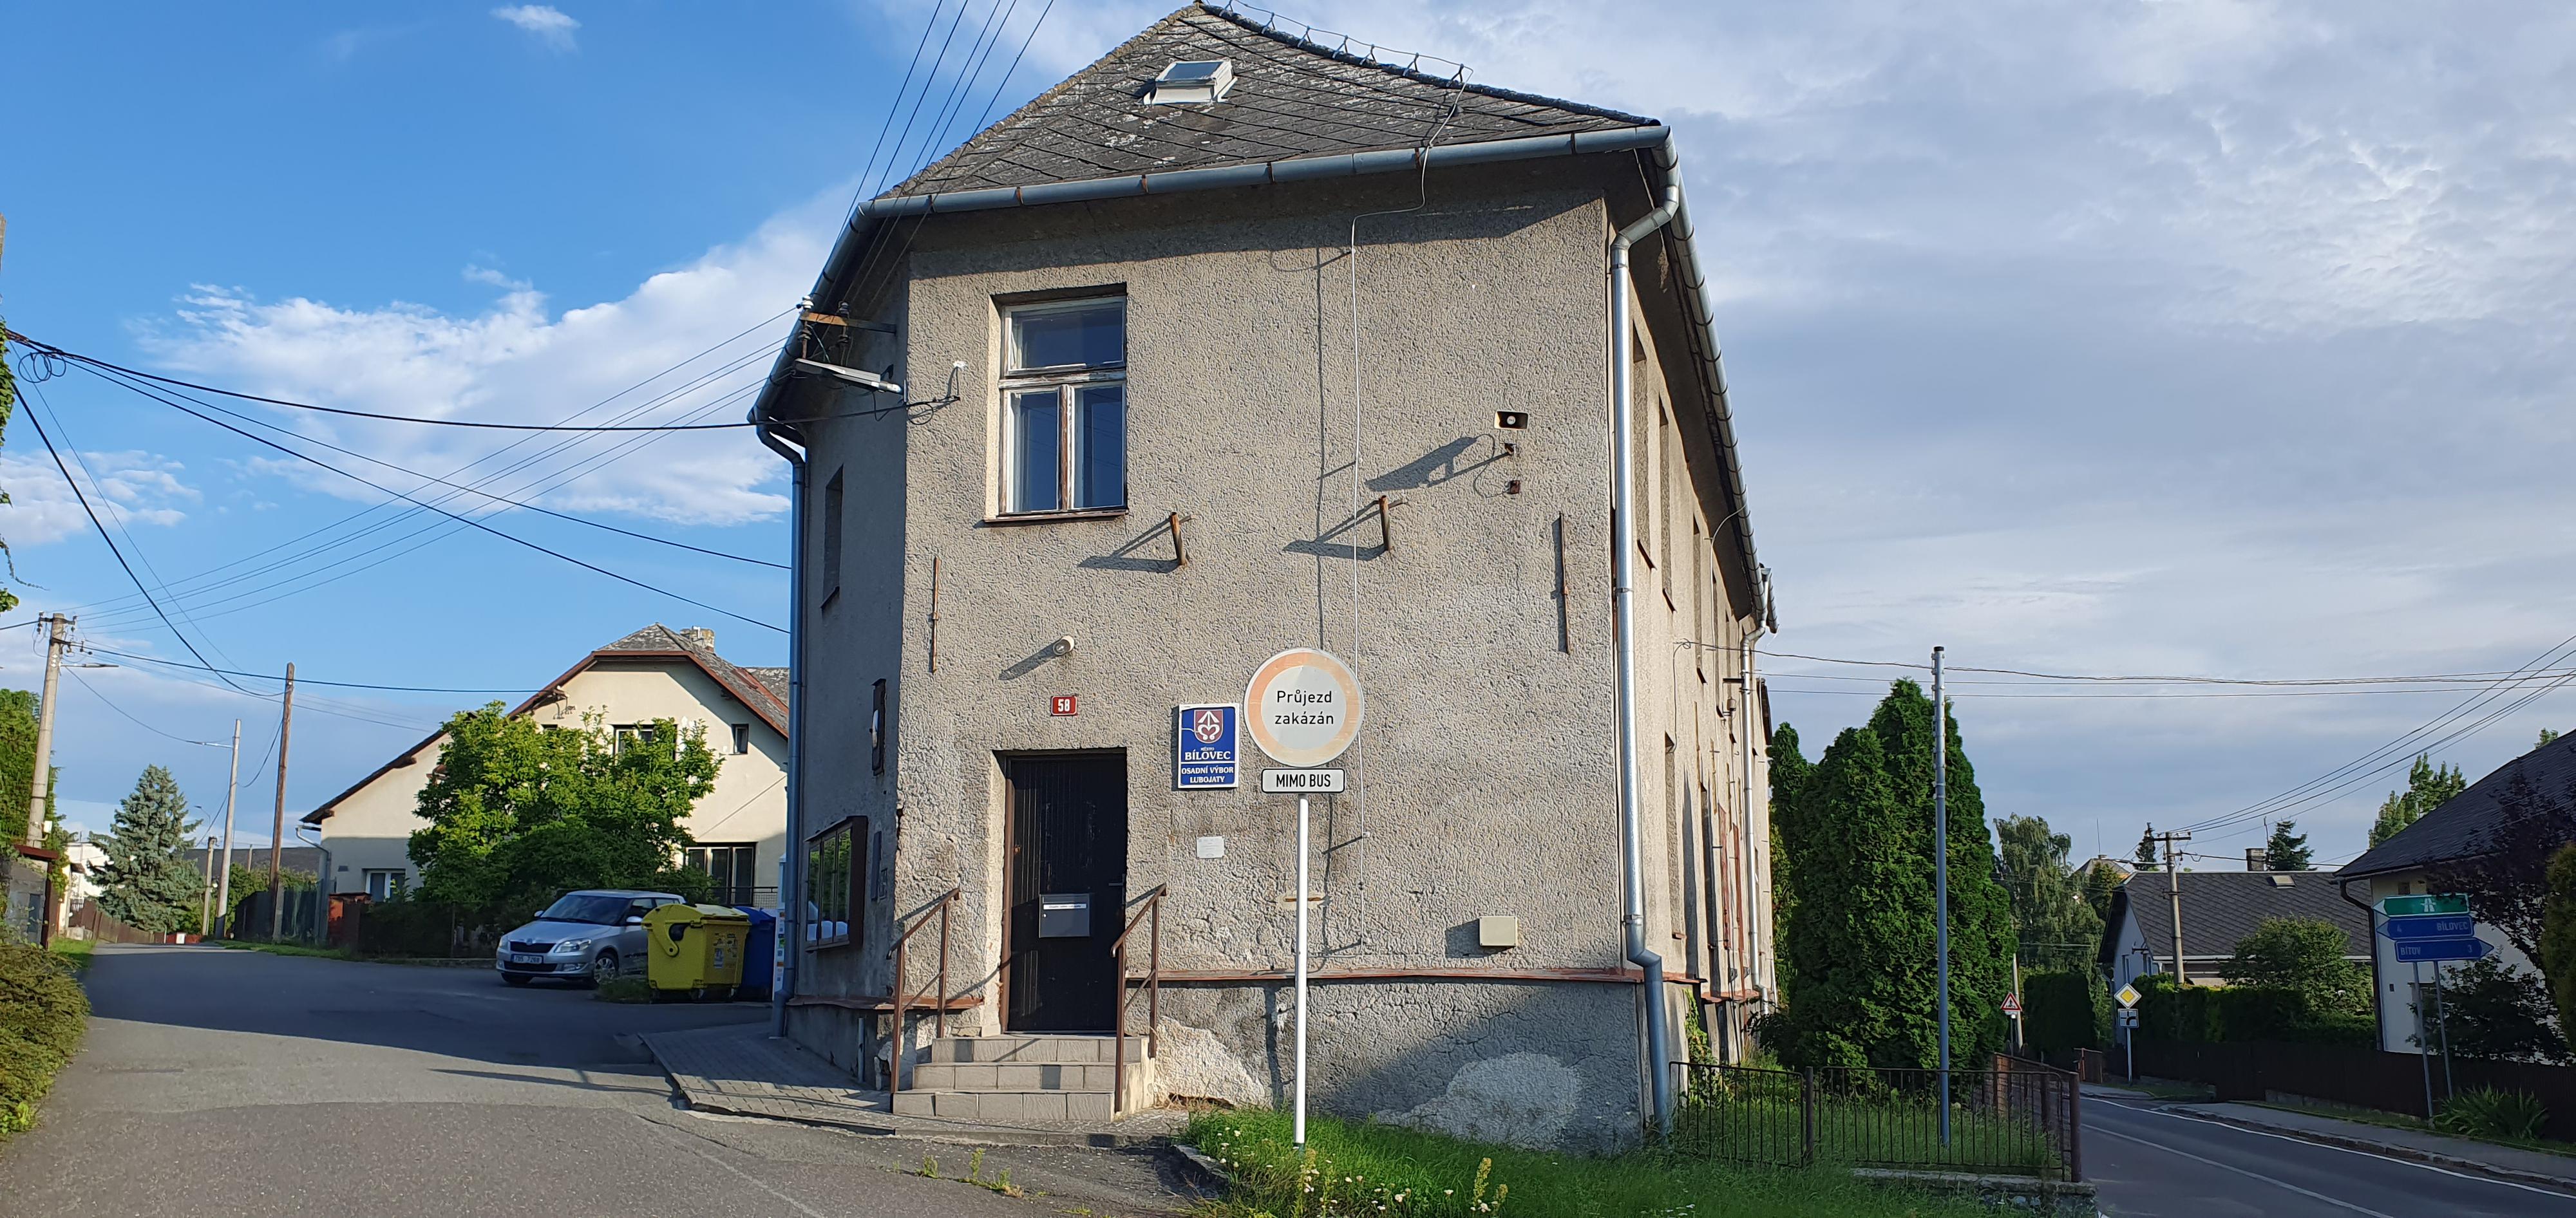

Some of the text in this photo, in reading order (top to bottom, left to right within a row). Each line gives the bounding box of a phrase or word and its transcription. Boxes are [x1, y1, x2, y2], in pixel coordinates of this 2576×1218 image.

[1277, 689, 1332, 706] Průjezd
[1057, 698, 1070, 712] 58
[1274, 711, 1334, 724] zakázán
[1184, 749, 1231, 760] BÍLOVEC
[1181, 765, 1234, 774] OSADNÍ VÝBOR
[1276, 774, 1331, 787] MIMO BUS
[2436, 921, 2468, 931] BÍLOVEC
[2400, 944, 2472, 955] BÍTOV 3
